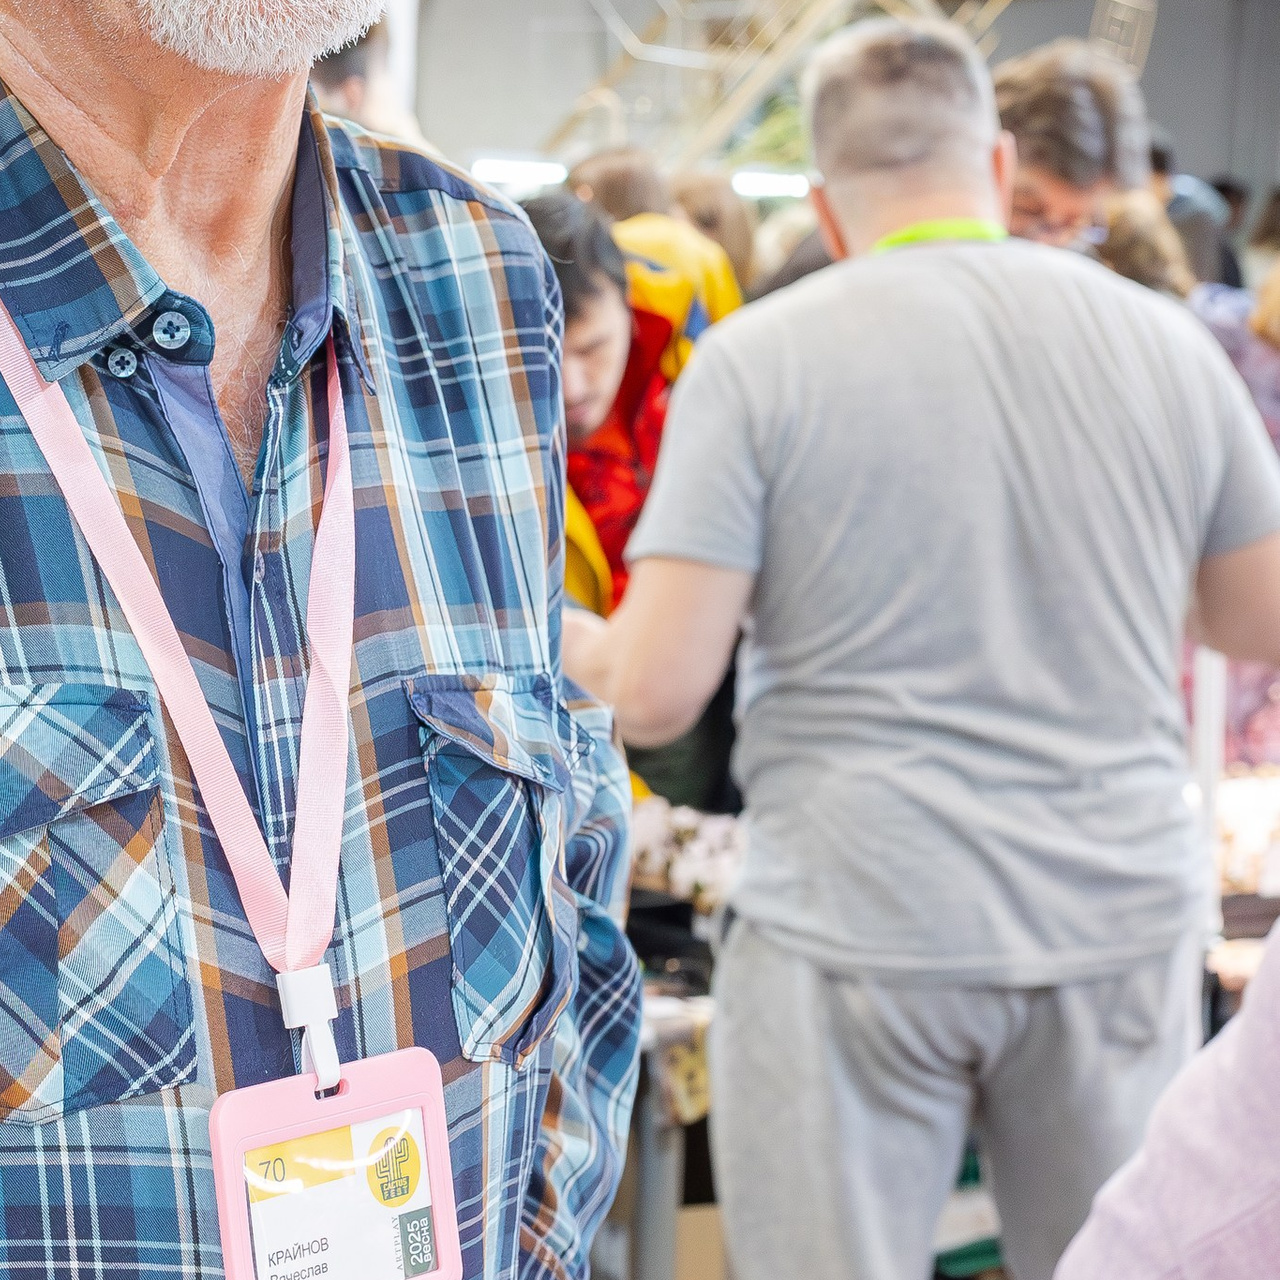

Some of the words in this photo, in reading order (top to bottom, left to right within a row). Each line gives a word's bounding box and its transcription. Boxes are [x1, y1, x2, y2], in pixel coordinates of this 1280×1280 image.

[258, 1157, 287, 1183] 70
[383, 1177, 408, 1192] CACTUS
[384, 1187, 408, 1200] FEST
[267, 1237, 330, 1268] КРАЙНОВ
[391, 1216, 403, 1271] ARTPLAY
[406, 1219, 424, 1266] 2025
